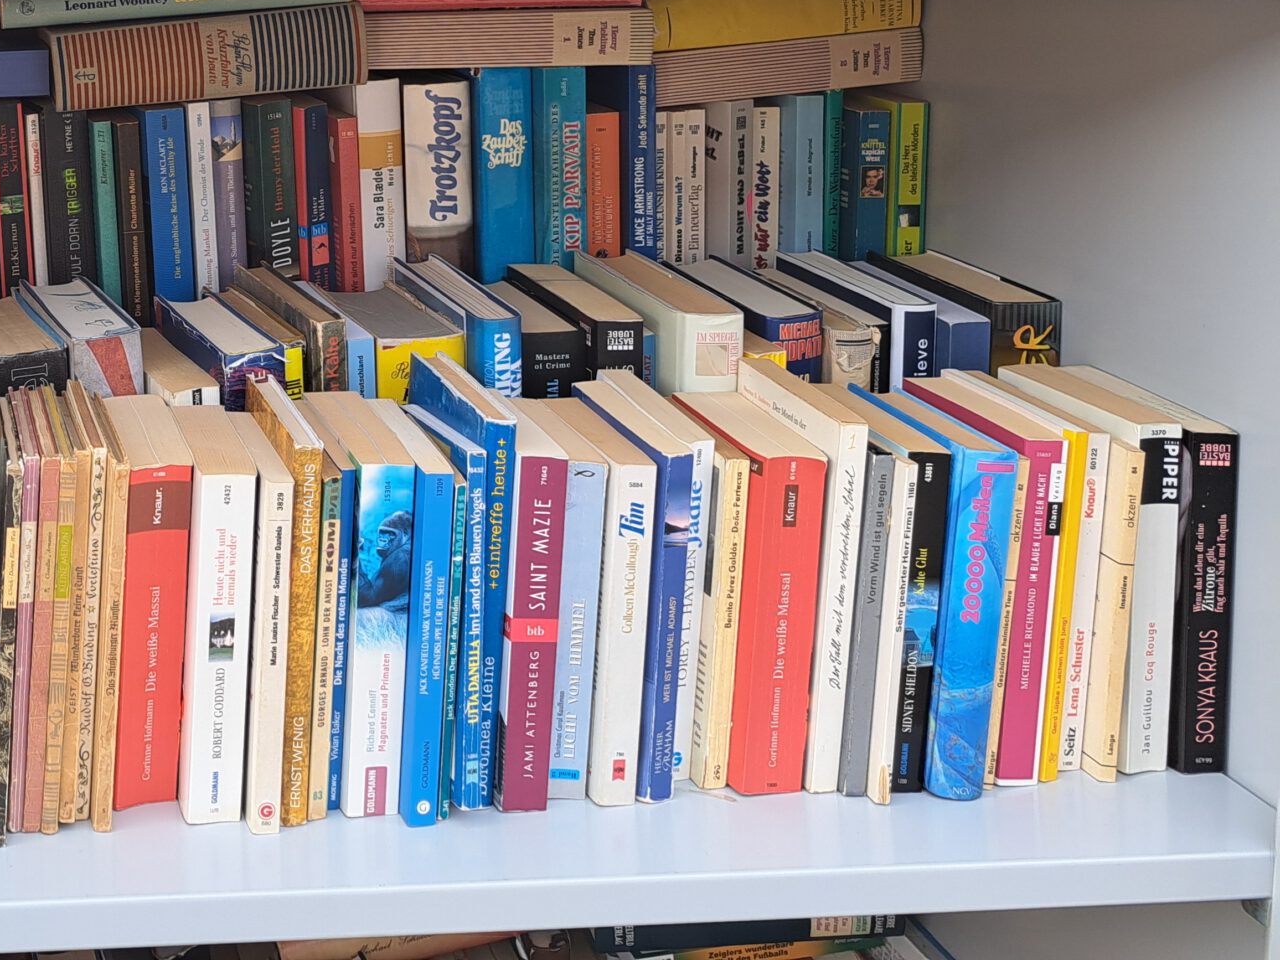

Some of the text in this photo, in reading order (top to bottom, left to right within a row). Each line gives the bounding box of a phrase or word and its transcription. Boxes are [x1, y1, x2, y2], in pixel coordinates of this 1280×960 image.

[425, 89, 463, 223] Trotzkopf
[534, 361, 571, 370] of Crime
[535, 352, 570, 361] Masters
[528, 498, 552, 611] SAINT MAZIE
[772, 572, 791, 679] Die weiße Massai
[1019, 588, 1036, 690] MICHELLE RICHMOND
[1145, 622, 1158, 681] Coq Rouge
[211, 667, 226, 759] ROBERT GODDARD
[522, 650, 540, 779] JAMI ATTENBERG
[901, 649, 918, 733] SIDNEY SHELDON
[1067, 628, 1085, 717] Lena Schuster
[1195, 630, 1217, 743] SONYA KRAUS
[1064, 727, 1077, 756] Seitz
[1141, 690, 1154, 754] Jan Guillou
